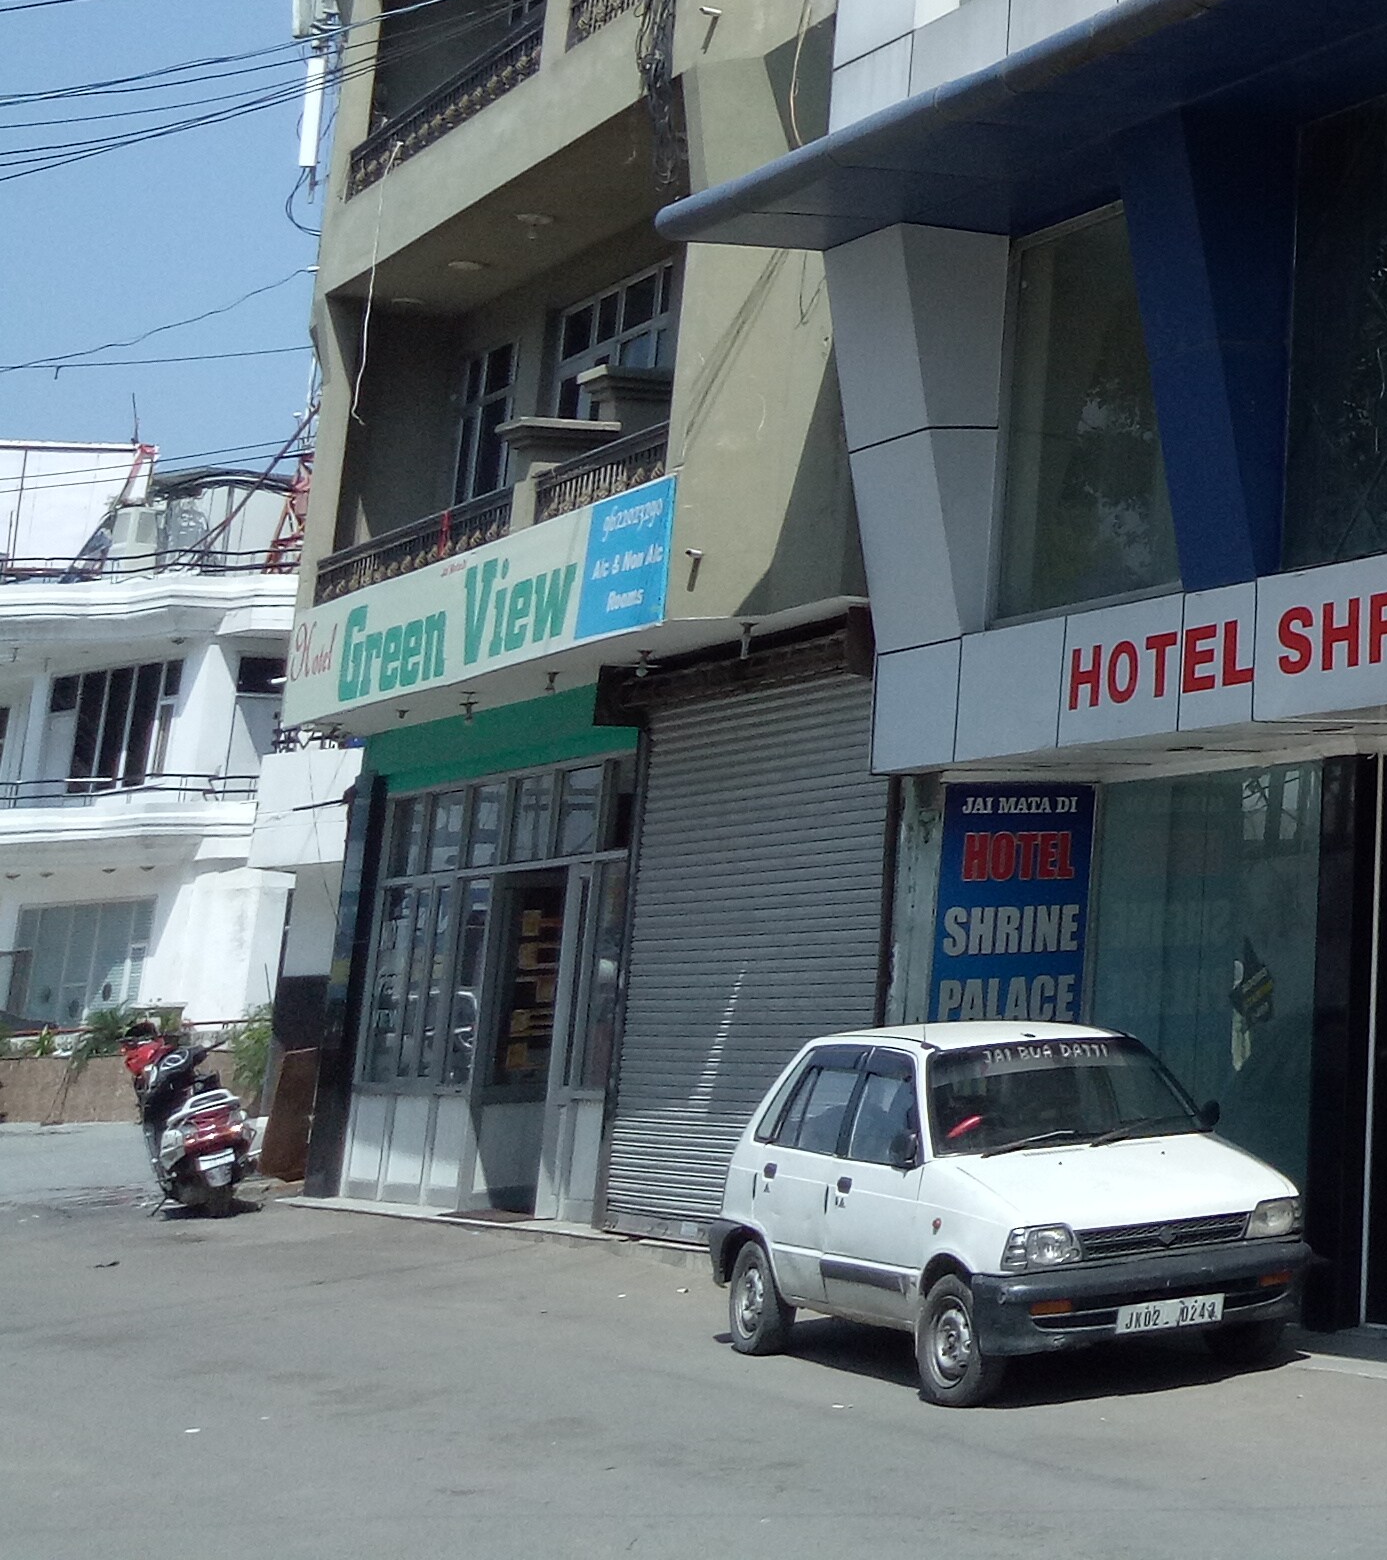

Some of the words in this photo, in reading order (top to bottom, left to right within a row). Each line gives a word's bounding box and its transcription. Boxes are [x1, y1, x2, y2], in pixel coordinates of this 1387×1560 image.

[606, 589, 645, 613] Rooms
[290, 621, 338, 681] Hotel
[338, 604, 447, 702] Green
[464, 557, 578, 665] View
[1068, 619, 1254, 711] HOTEL
[962, 797, 994, 814] JAI
[998, 796, 1052, 814] MATA
[1055, 796, 1078, 813] DI
[962, 831, 1075, 882] HOTEL
[943, 904, 1079, 957] SHRINE
[937, 974, 1075, 1022] PALACE
[1125, 1308, 1161, 1329] JK02
